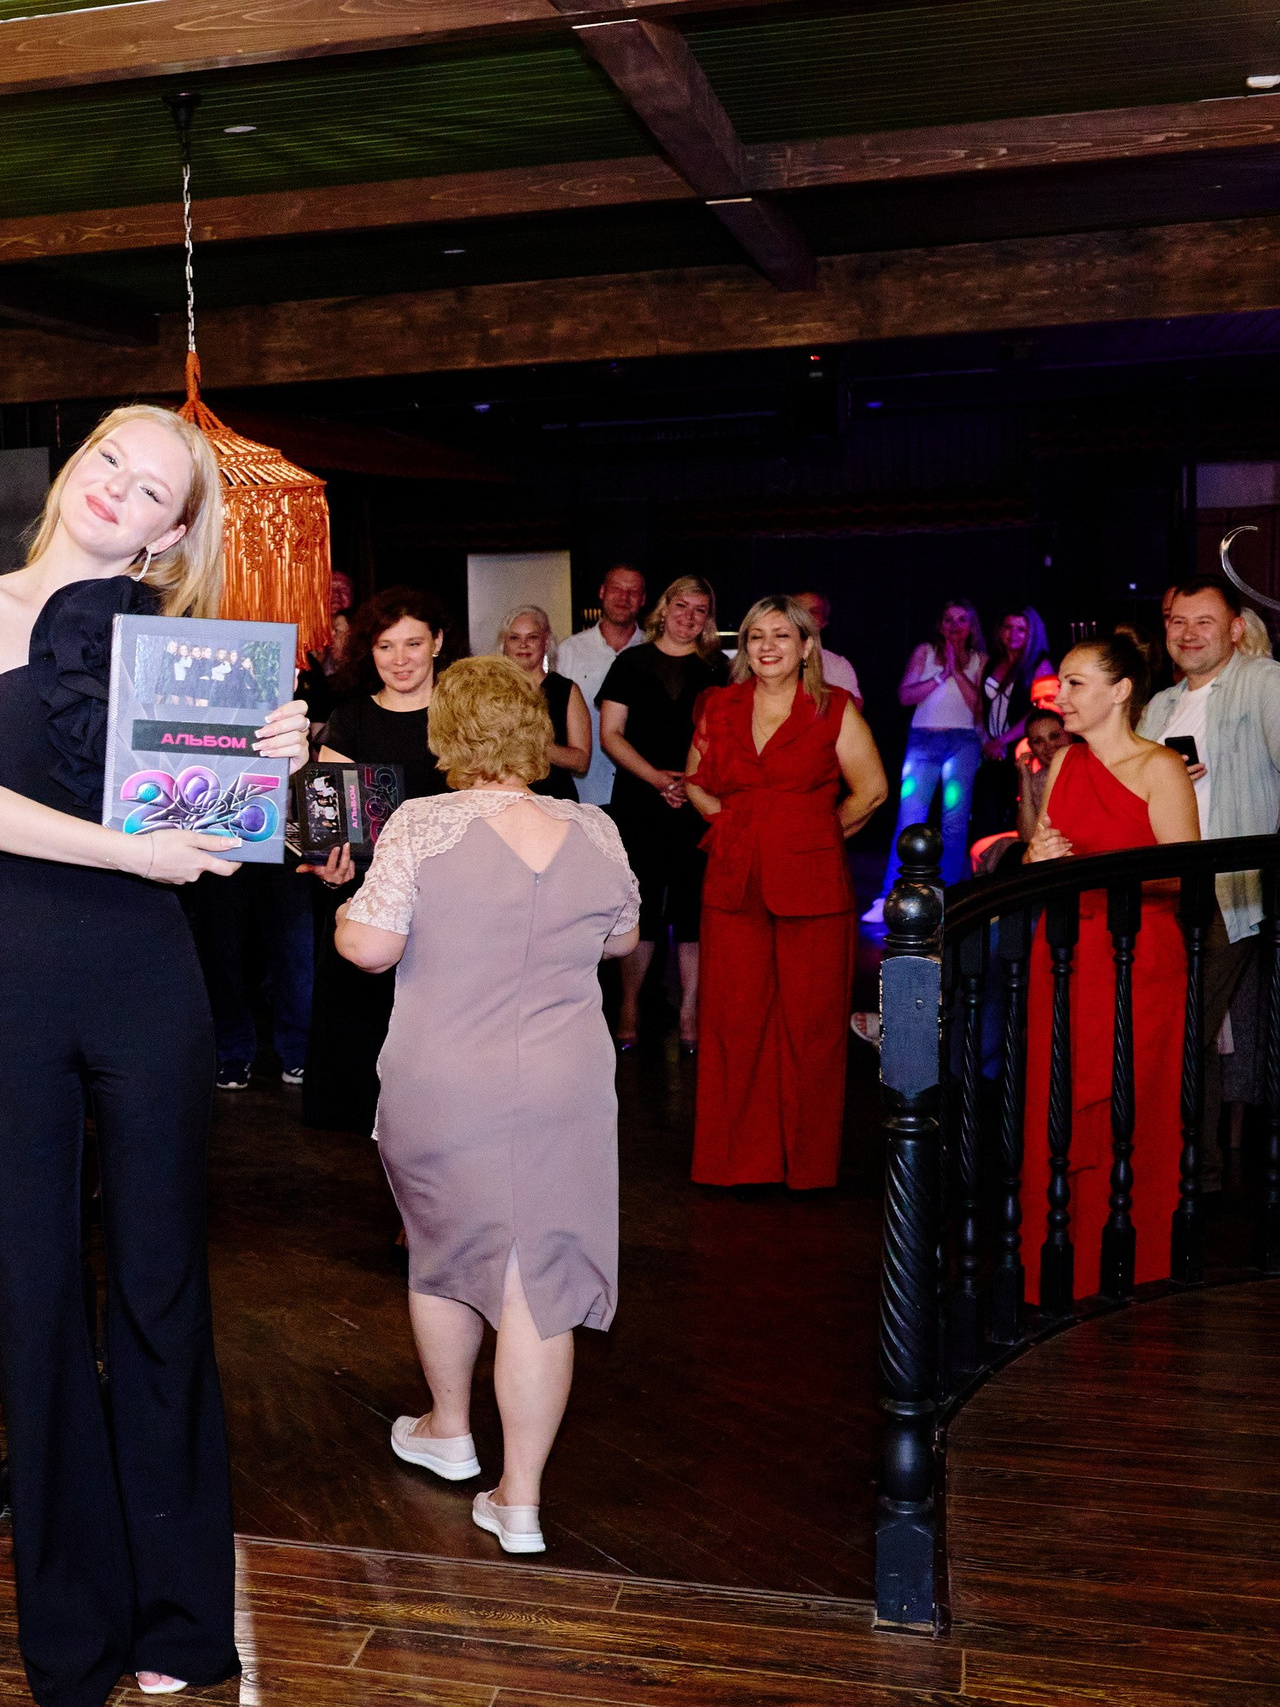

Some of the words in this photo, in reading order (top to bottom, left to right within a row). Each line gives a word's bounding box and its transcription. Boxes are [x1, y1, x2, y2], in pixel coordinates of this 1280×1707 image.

[160, 733, 247, 749] АЛЬБОМ
[120, 765, 281, 843] 2025
[349, 785, 359, 829] АЛЬБОМ
